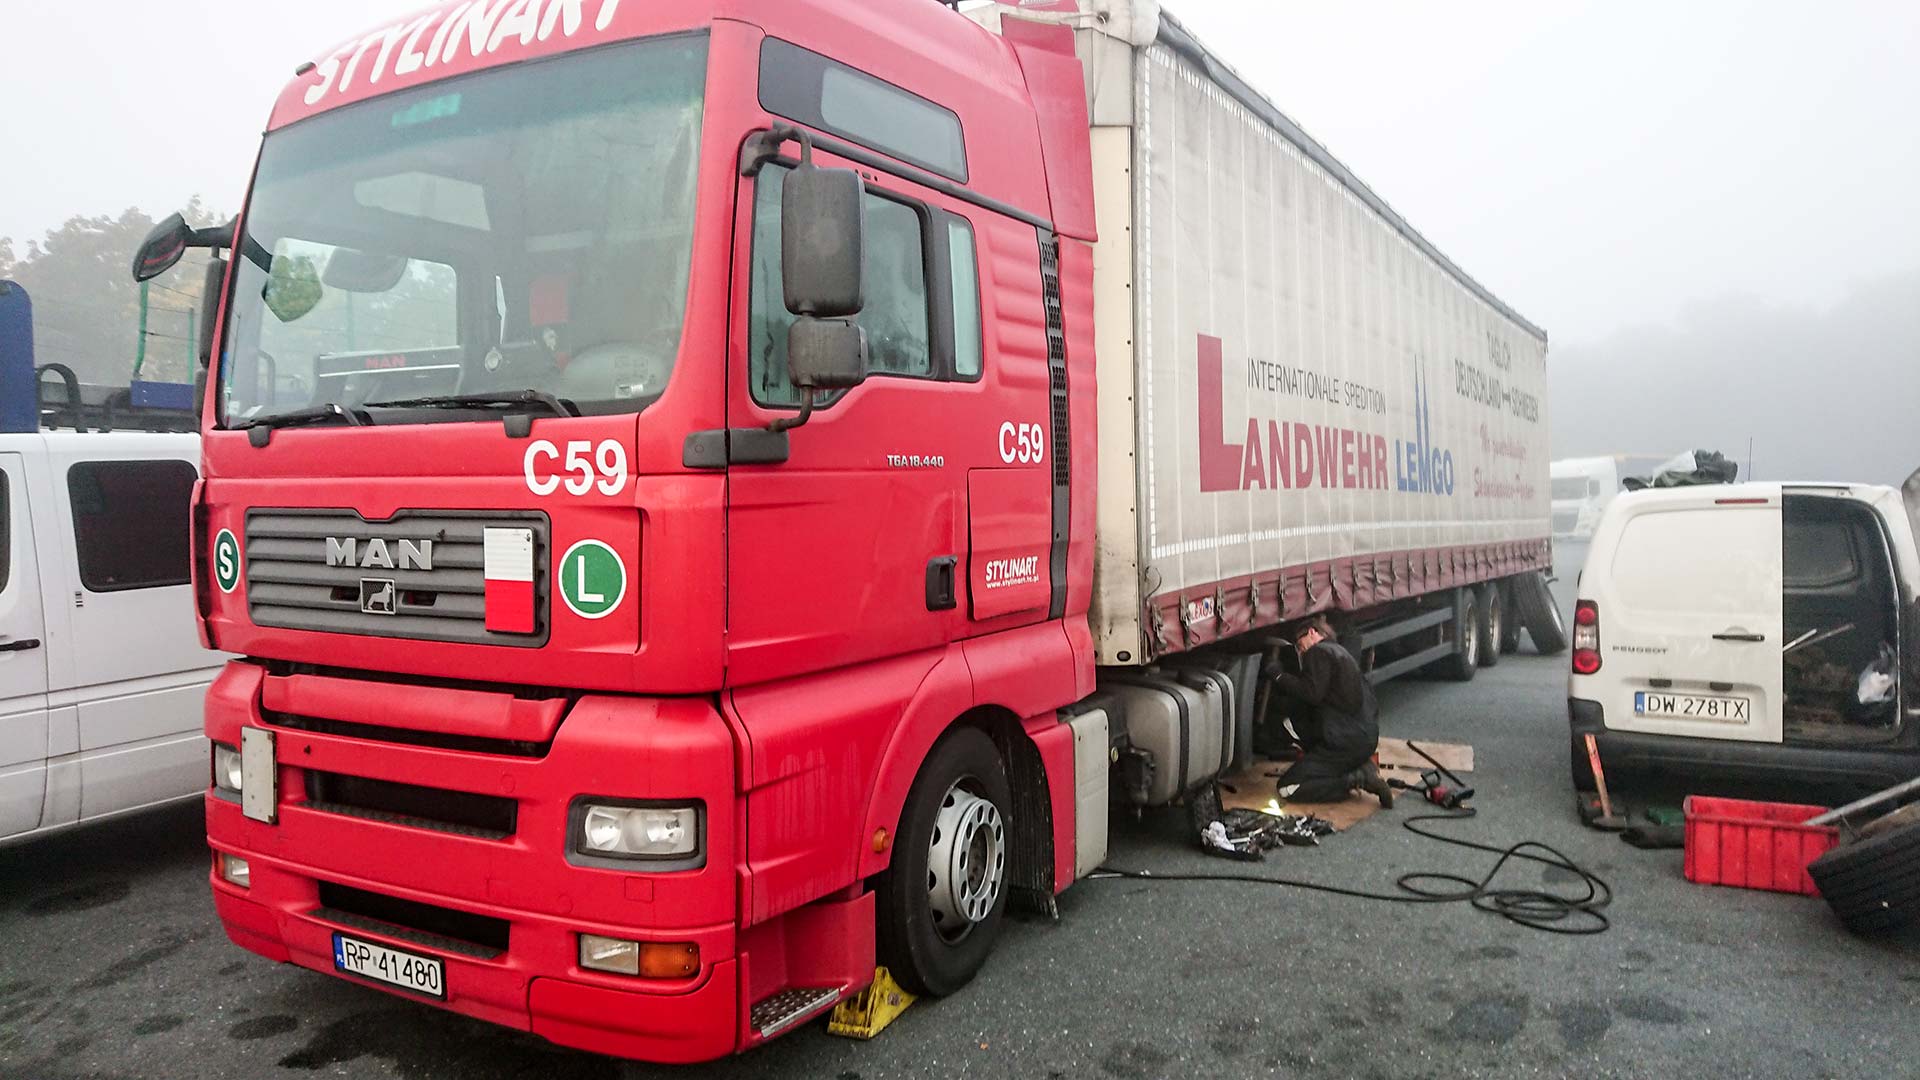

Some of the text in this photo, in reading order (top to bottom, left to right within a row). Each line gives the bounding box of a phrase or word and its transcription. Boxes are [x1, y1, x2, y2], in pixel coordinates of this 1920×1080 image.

[1247, 357, 1386, 415] INTERNATIONALE SPEDITION
[1197, 333, 1389, 492] LANDWEHR
[999, 421, 1044, 464] C59
[524, 439, 628, 496] C59
[219, 543, 234, 580] S
[325, 537, 433, 571] MAN
[985, 556, 1038, 582] STYLINART
[577, 555, 605, 603] L
[1612, 645, 1668, 654] PEUGEOT
[1648, 696, 1745, 718] DW 278TX
[345, 942, 438, 989] RP 41480
